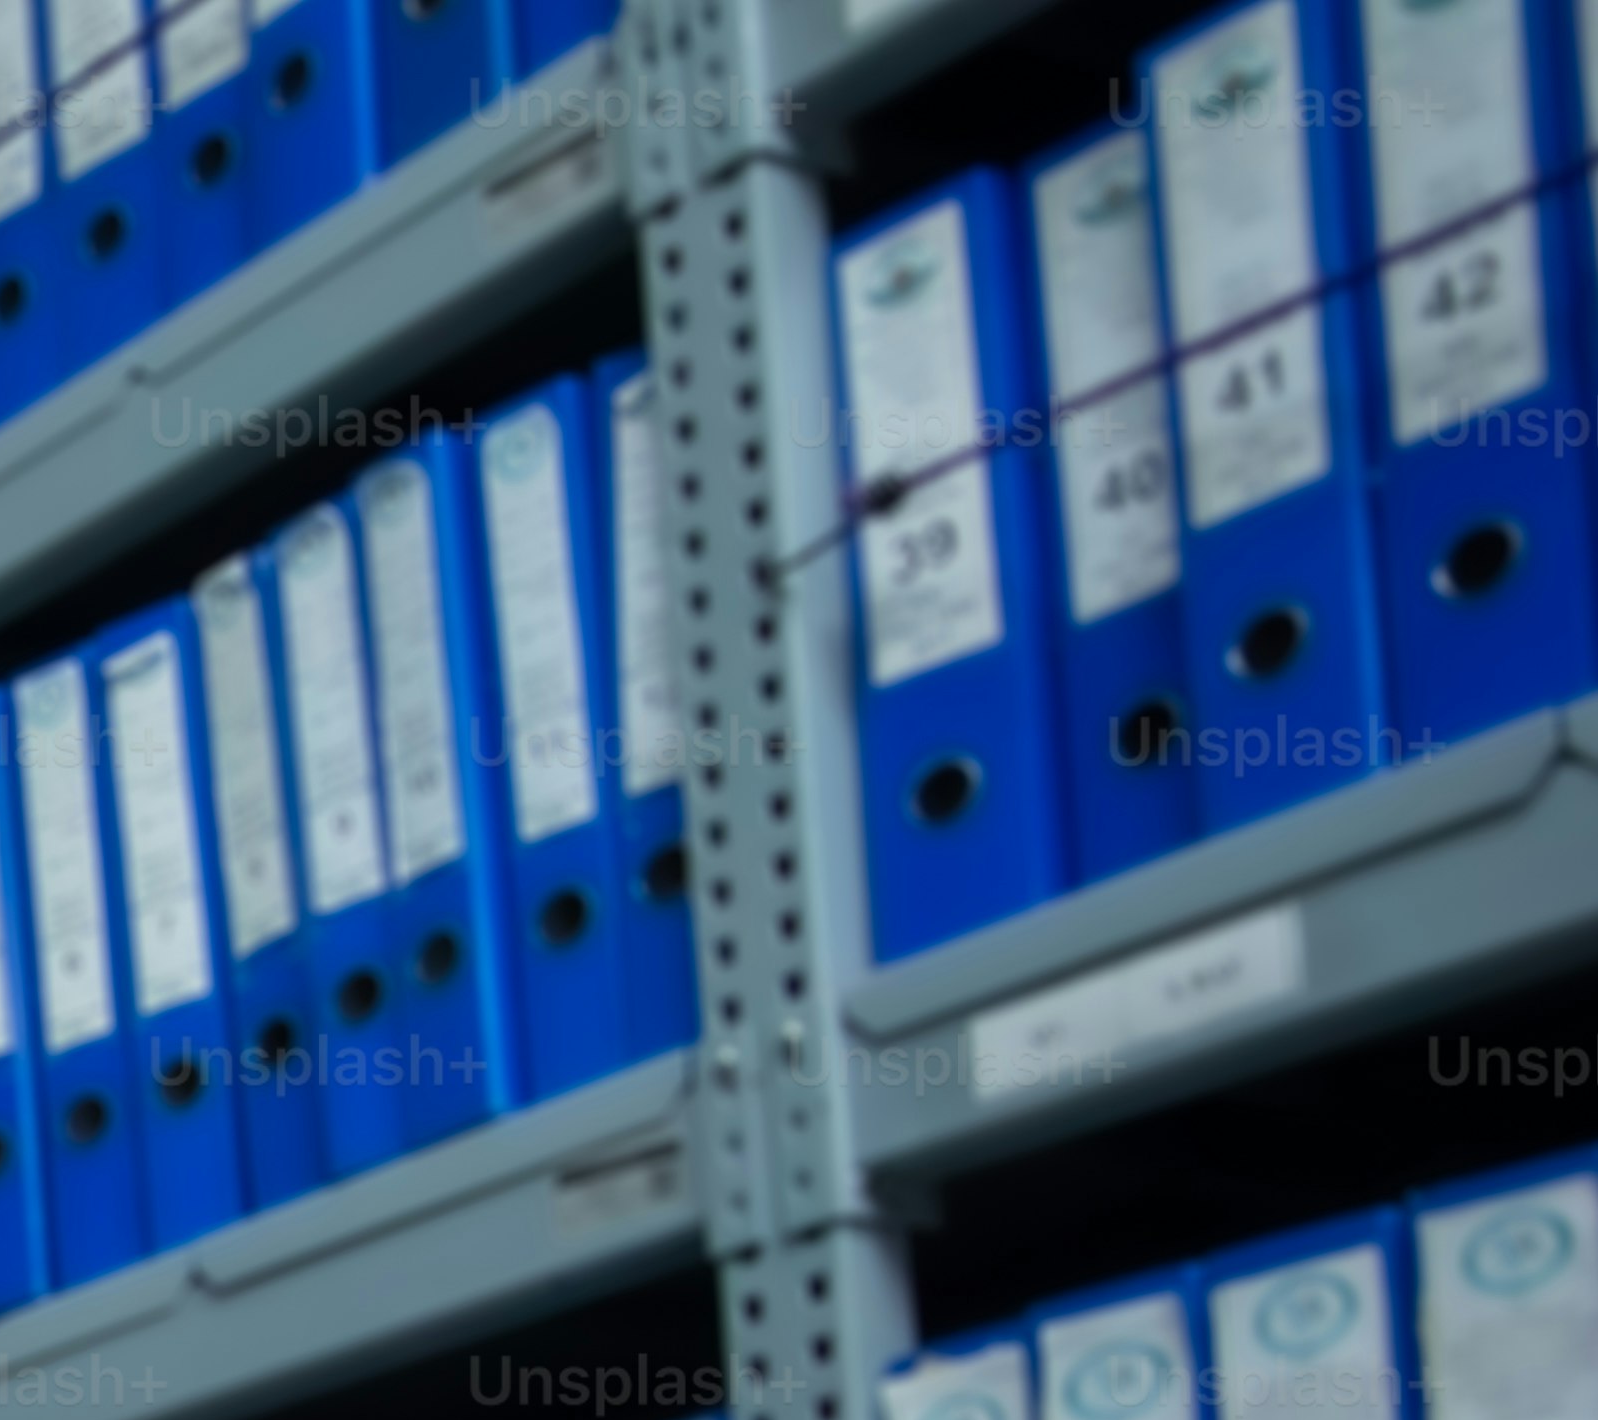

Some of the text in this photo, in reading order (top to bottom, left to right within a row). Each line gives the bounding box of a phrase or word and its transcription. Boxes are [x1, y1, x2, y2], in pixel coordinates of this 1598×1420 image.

[1419, 250, 1503, 323] 42
[1214, 348, 1286, 414] 41
[1092, 450, 1170, 515] 40
